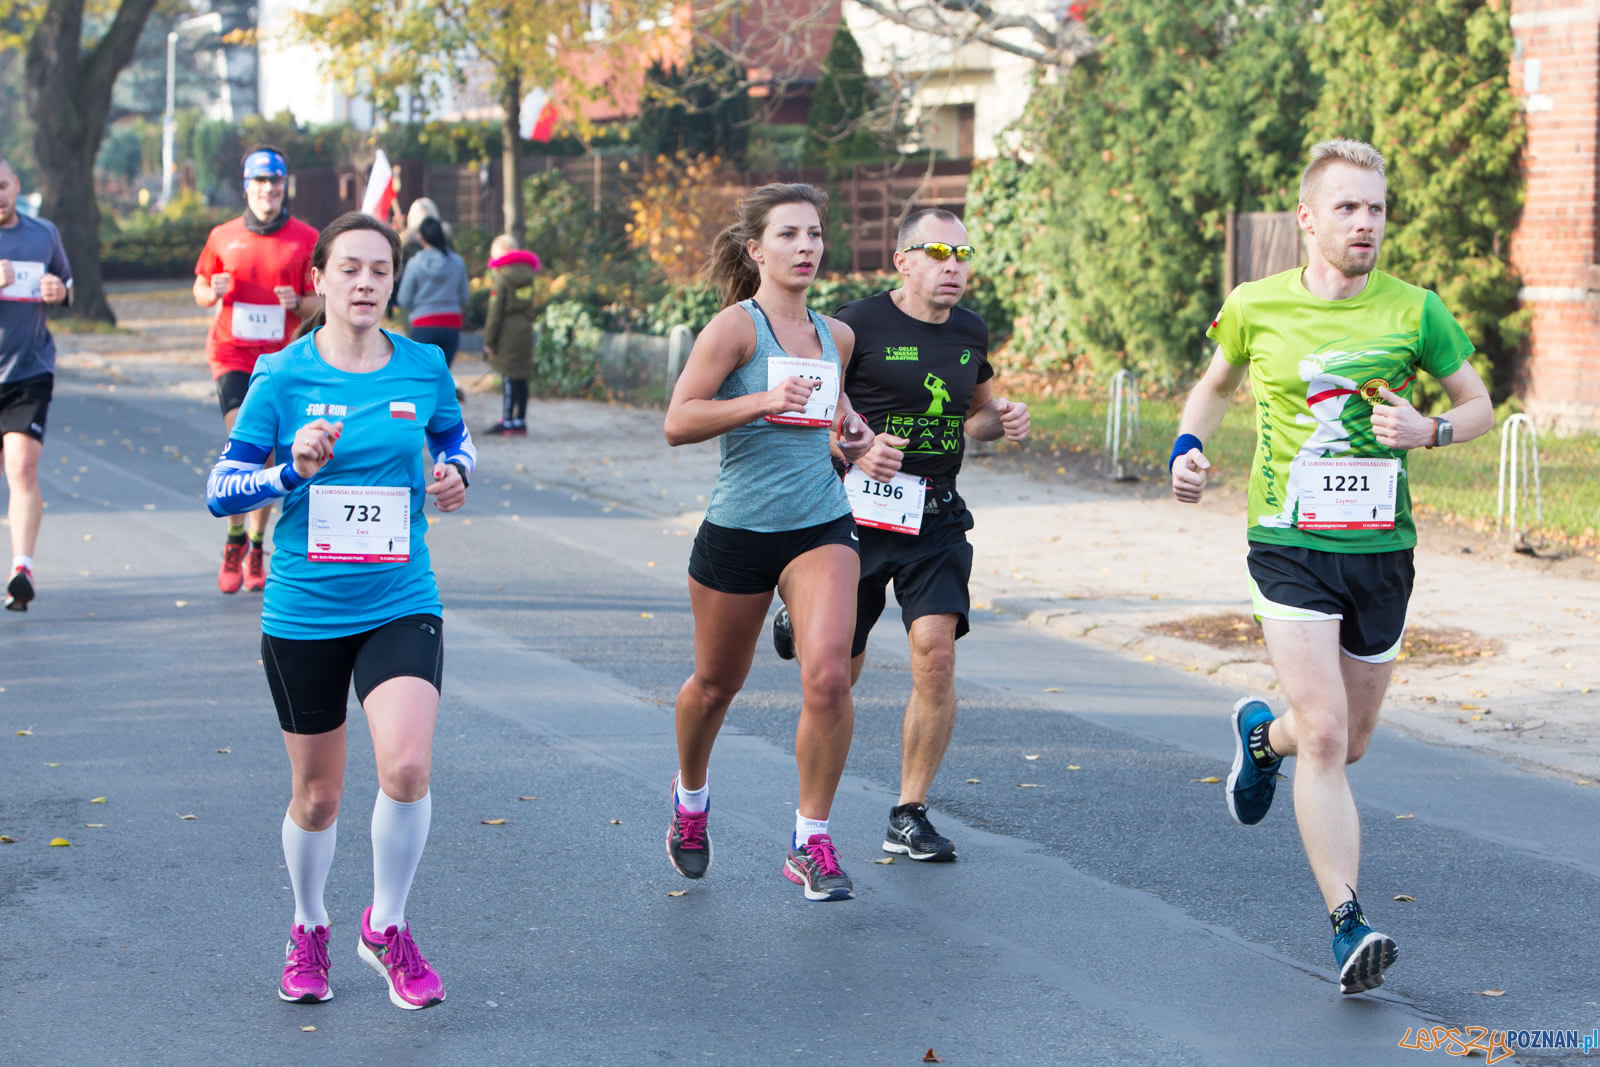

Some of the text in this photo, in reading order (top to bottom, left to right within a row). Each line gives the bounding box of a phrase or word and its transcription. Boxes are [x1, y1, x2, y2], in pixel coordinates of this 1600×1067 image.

[892, 416, 914, 426] 22
[918, 418, 939, 426] 04
[862, 480, 904, 500] 1196
[1322, 476, 1370, 492] 1221
[344, 504, 381, 522] 732
